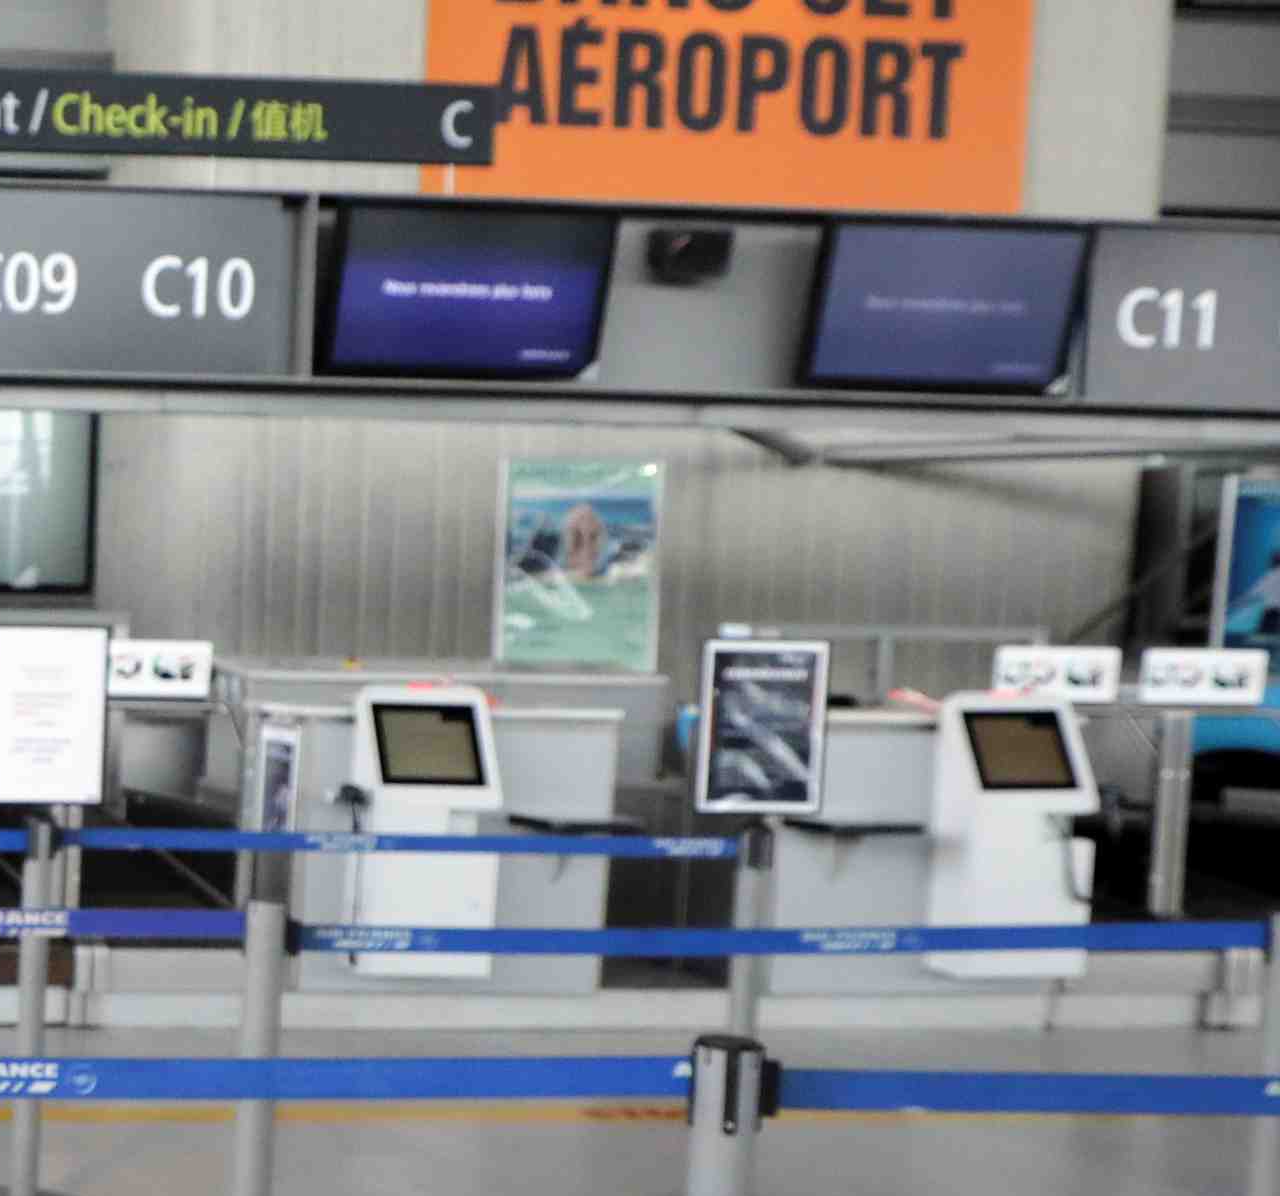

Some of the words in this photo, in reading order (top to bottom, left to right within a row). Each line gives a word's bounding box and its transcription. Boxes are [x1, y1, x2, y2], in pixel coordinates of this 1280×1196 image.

[496, 16, 966, 141] AÉROPORT
[53, 91, 218, 139] Check-in
[252, 100, 328, 142] 值机
[440, 99, 476, 149] C
[141, 255, 255, 320] C10
[1117, 286, 1217, 349] C11
